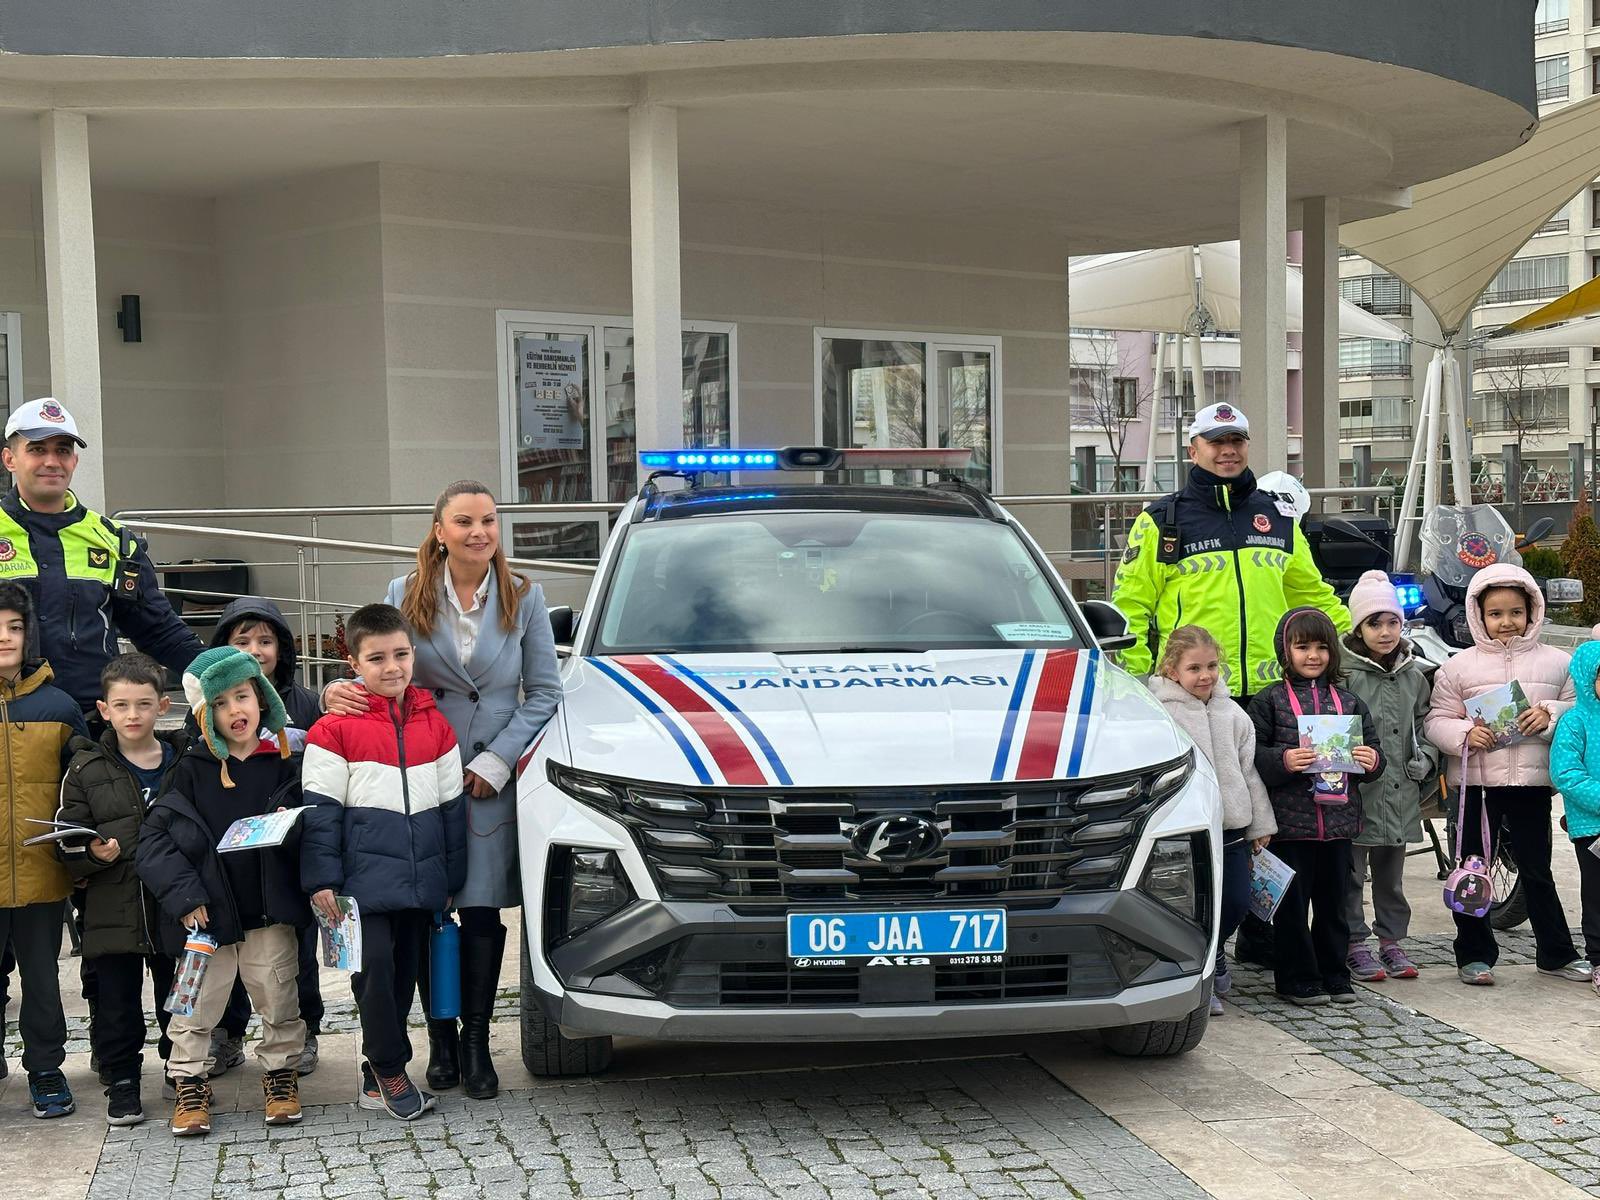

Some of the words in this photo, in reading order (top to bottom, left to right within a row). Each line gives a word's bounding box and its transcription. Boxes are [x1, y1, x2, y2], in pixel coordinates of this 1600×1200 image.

[783, 663, 935, 675] TRAFİK
[726, 675, 1009, 690] JANDARMASI
[809, 918, 846, 952] 06
[867, 916, 924, 951] JAA
[949, 914, 1000, 949] 717
[866, 956, 931, 967] Ata
